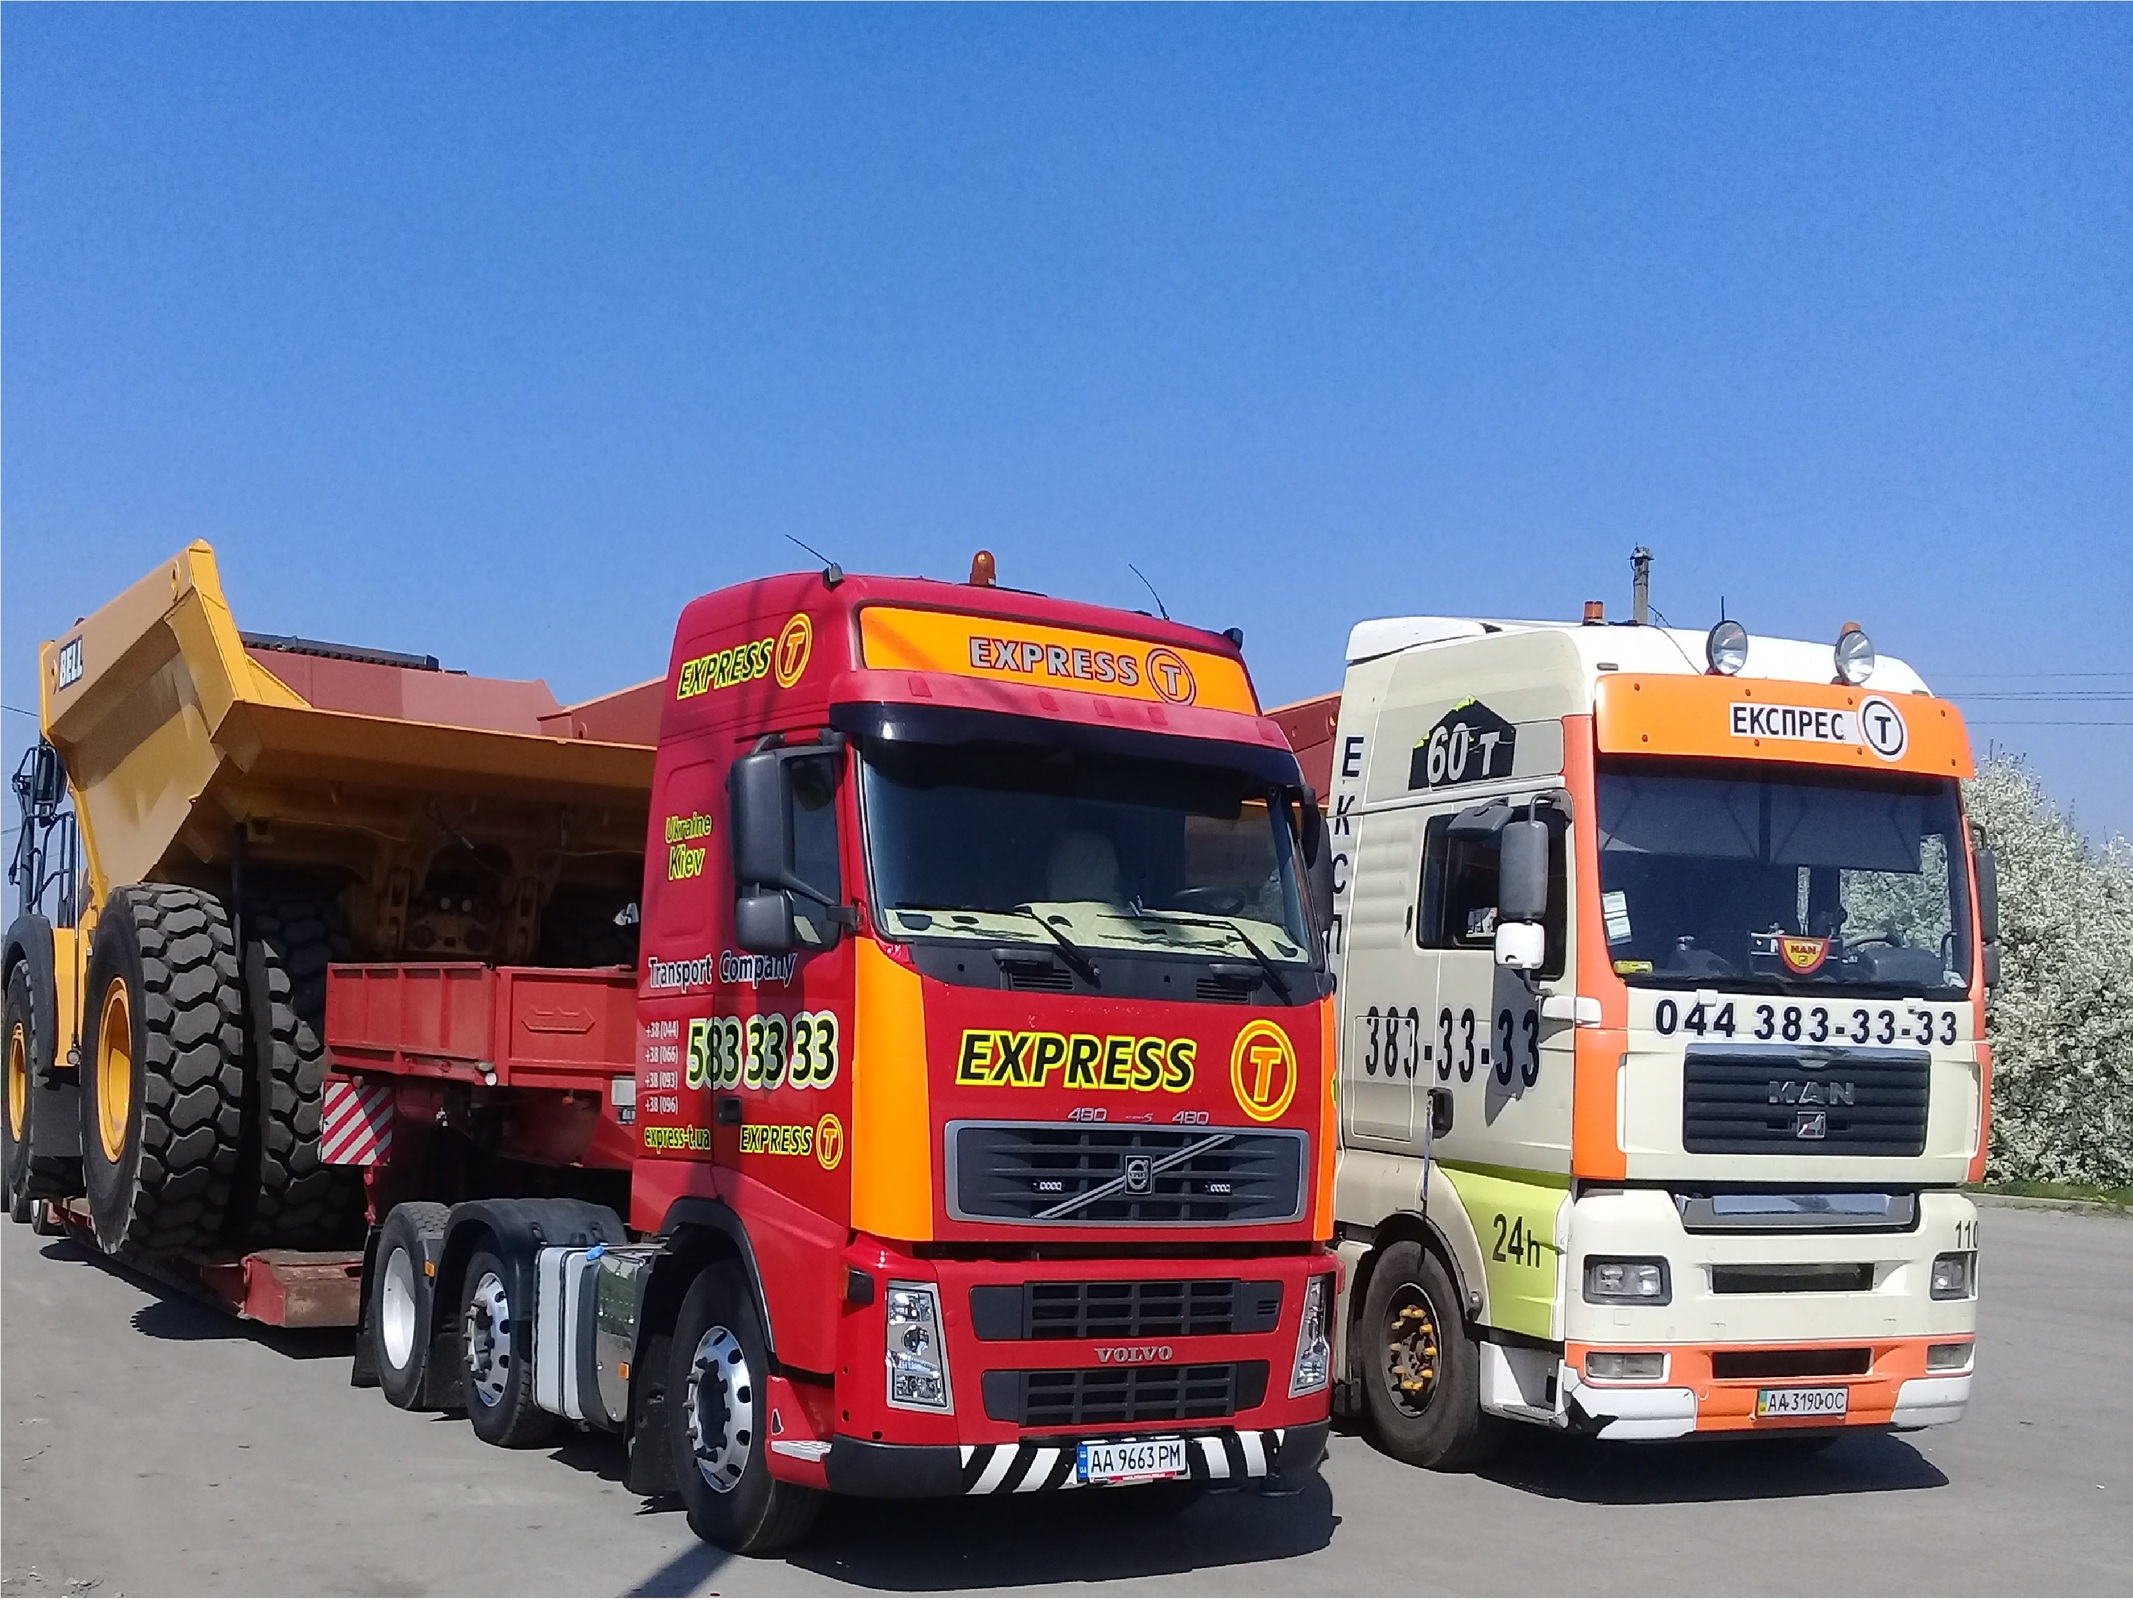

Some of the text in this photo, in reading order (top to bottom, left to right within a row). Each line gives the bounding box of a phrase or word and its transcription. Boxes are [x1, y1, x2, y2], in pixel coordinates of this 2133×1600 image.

[60, 638, 83, 689] BELL
[676, 636, 775, 700] EXPRESS
[969, 636, 1139, 686] EXPRESS
[1733, 706, 1846, 741] ЕКСПРЕС
[1427, 722, 1469, 784] 60
[665, 812, 712, 843] Ukraine
[668, 843, 706, 880] Kiev
[1791, 945, 1817, 954] MAN
[649, 950, 797, 994] Transport Company
[1655, 999, 1957, 1046] 044 383-33-33
[687, 1020, 742, 1085] 583
[955, 1029, 1197, 1093] EXPRESS
[1365, 1006, 1540, 1088] 383-33-33
[1768, 1080, 1855, 1106] MAN
[1067, 1107, 1107, 1122] 480
[1171, 1110, 1210, 1125] 480
[645, 1125, 711, 1154] express-t.ua
[739, 1125, 814, 1156] EXPRESS
[1492, 1213, 1540, 1268] 24h
[1094, 1346, 1173, 1363] VOLVO
[1091, 1450, 1114, 1473] AA
[1118, 1446, 1155, 1472] 9663
[1159, 1444, 1181, 1468] PM
